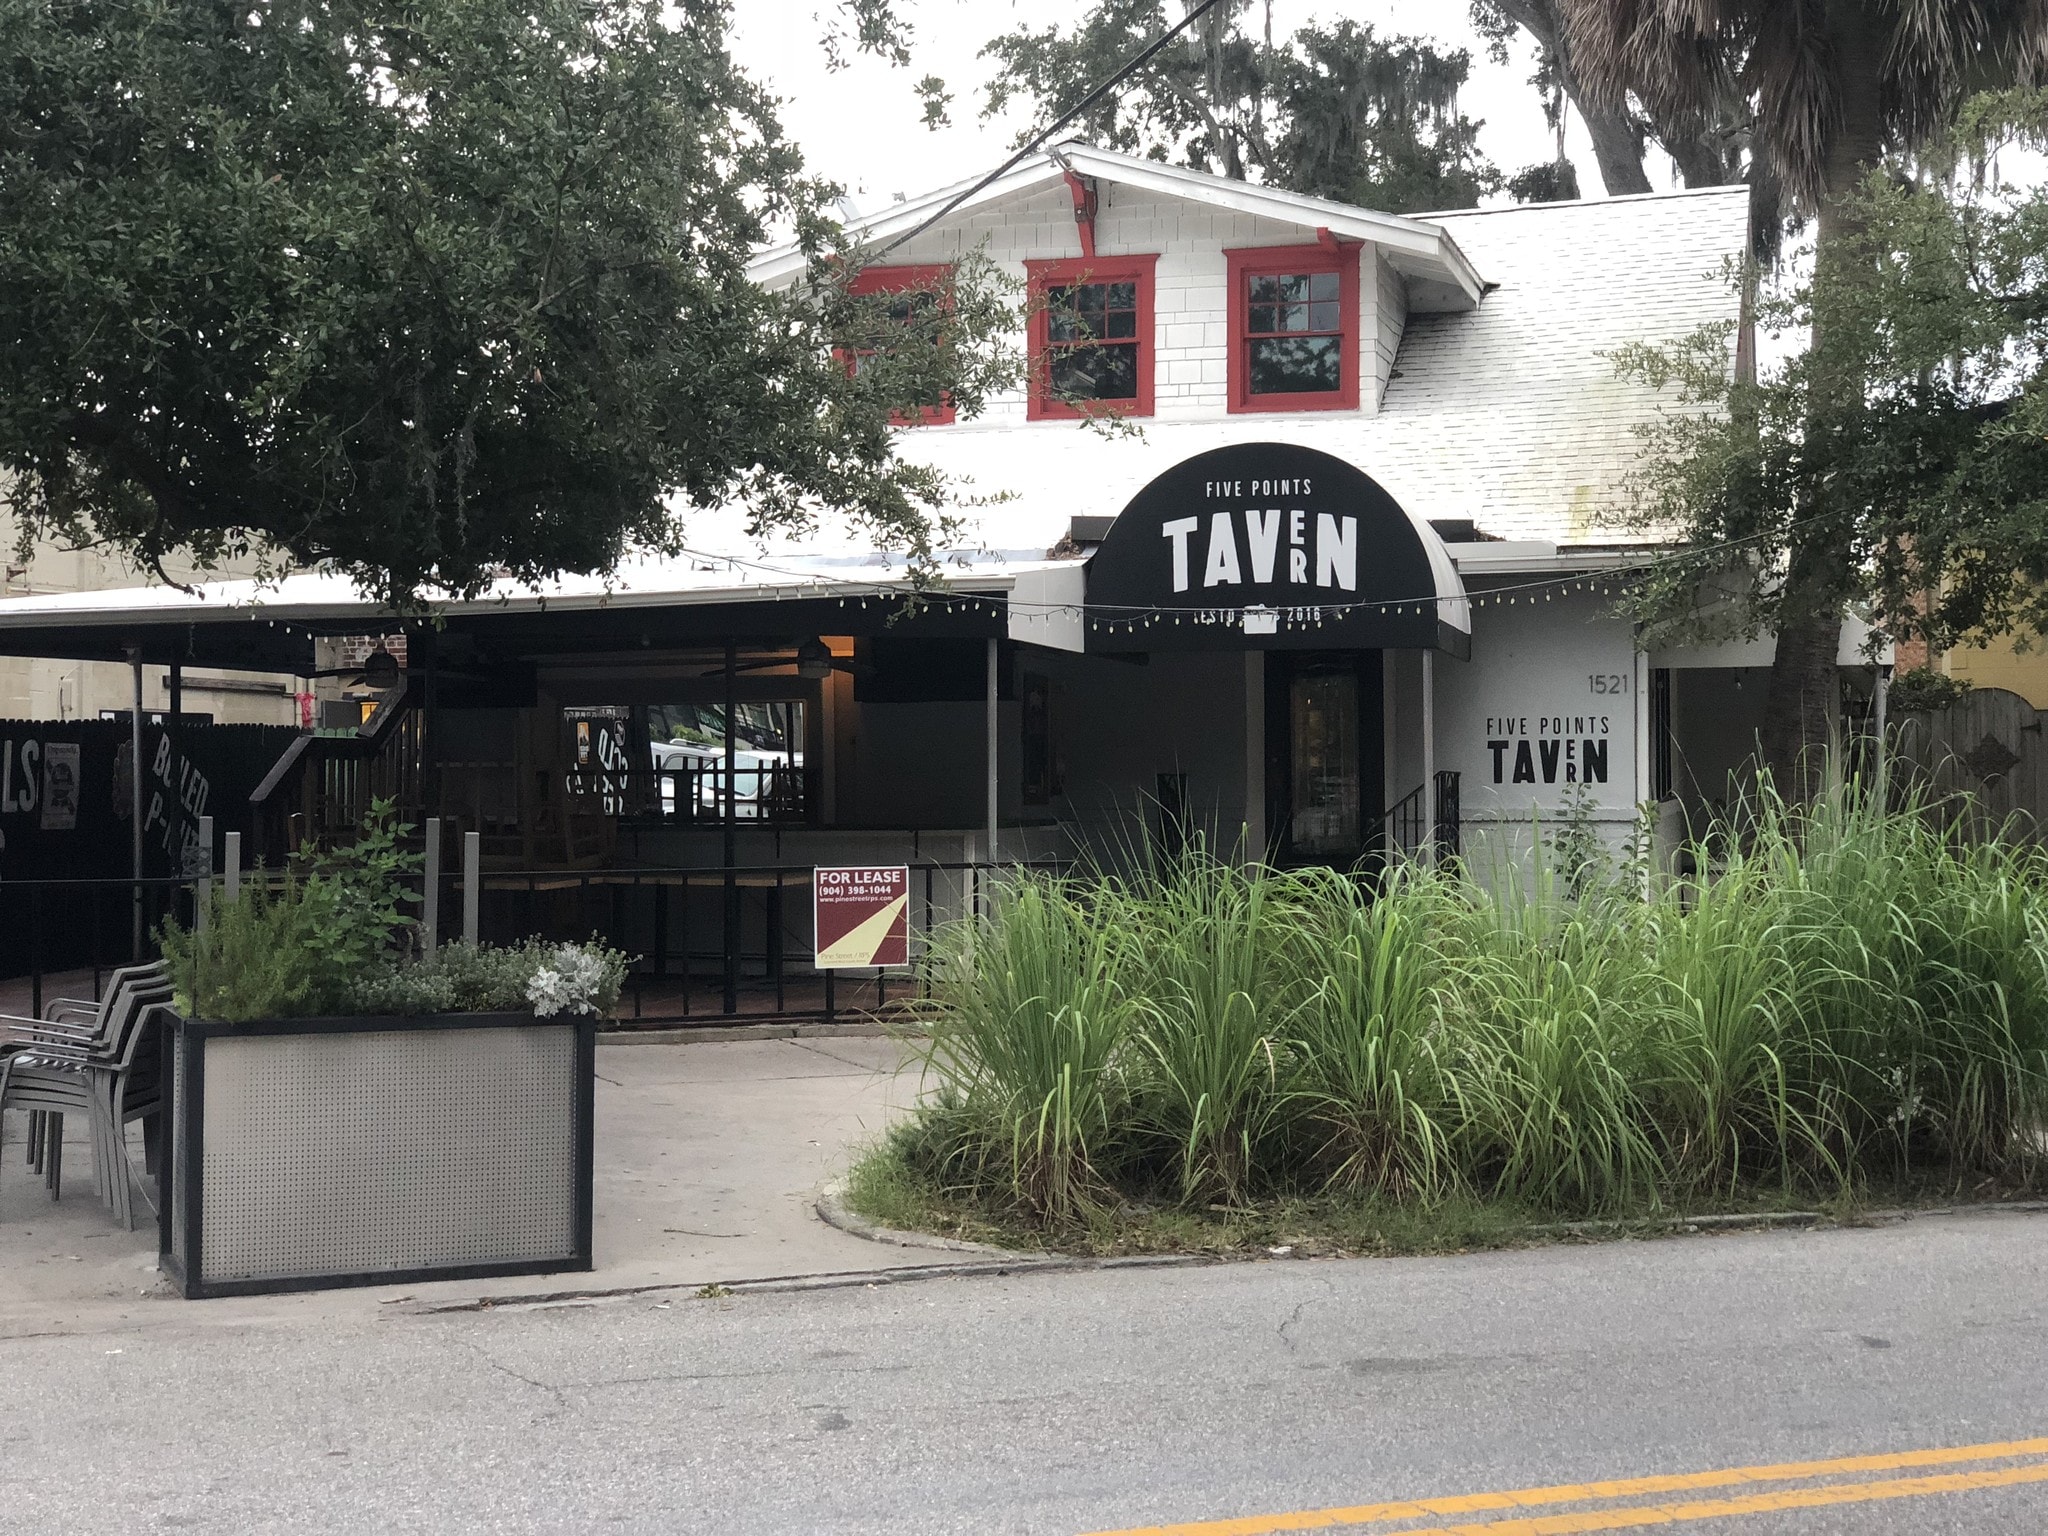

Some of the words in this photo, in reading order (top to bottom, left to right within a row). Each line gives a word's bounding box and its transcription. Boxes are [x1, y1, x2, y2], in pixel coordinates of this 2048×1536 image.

[1206, 480, 1242, 498] FIVE
[1252, 478, 1312, 496] POINTS
[1162, 509, 1358, 593] TAVERN
[1287, 607, 1321, 622] 2016
[1588, 674, 1628, 694] 1521
[1486, 717, 1527, 735] FIVE
[1540, 716, 1609, 735] POINTS
[1487, 739, 1608, 784] TAVERN
[819, 871, 851, 885] FOR
[855, 870, 901, 884] LEASE
[819, 885, 844, 896] (904)
[847, 885, 892, 895] 398-1044
